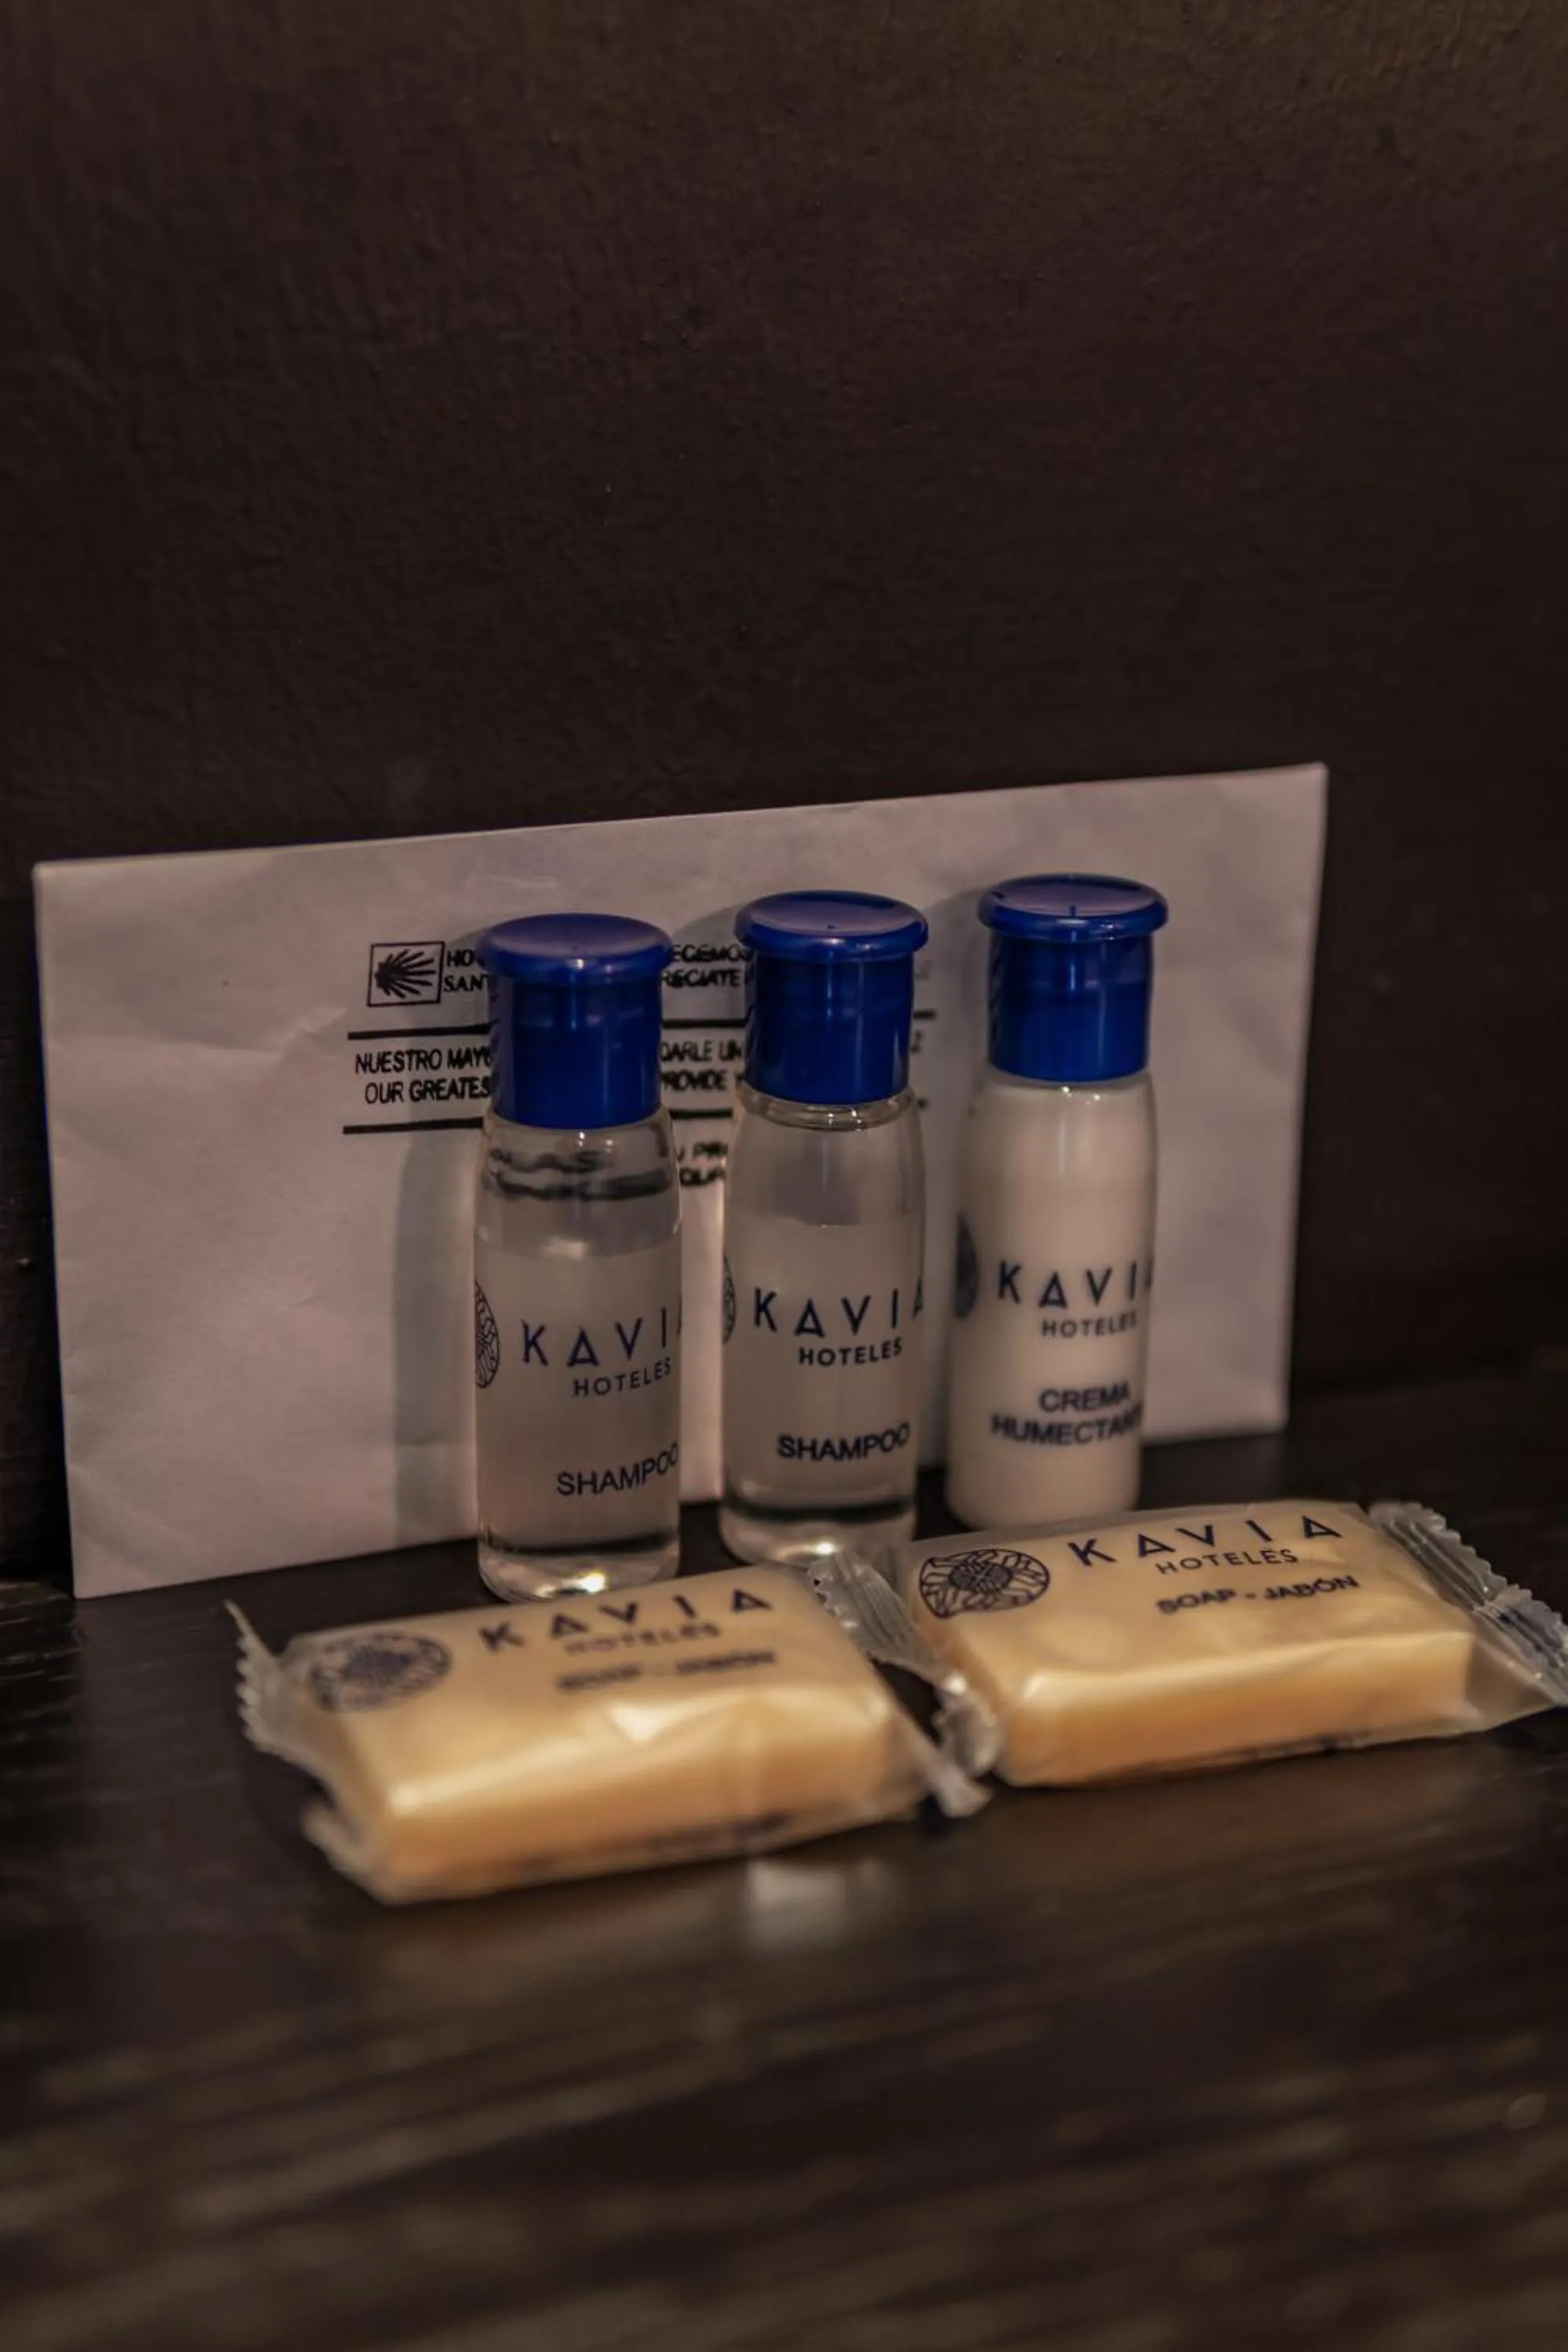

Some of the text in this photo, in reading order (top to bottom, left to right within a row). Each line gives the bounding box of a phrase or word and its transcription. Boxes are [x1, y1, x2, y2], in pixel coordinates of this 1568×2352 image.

[446, 948, 483, 967] HO
[355, 1047, 441, 1074] NUESTRO
[447, 1046, 494, 1070] MAYO
[365, 1080, 404, 1105] OUR
[408, 1075, 495, 1102] GREATES
[520, 1304, 681, 1367] KAVI
[798, 1336, 902, 1367] HOTELES
[572, 1357, 672, 1398] HOTELES
[777, 1421, 910, 1461] SHAMPOO
[557, 1439, 679, 1496] SHAMPOO
[1067, 1515, 1343, 1566] KAVIA
[1155, 1548, 1298, 1576] HOTELES
[1156, 1588, 1236, 1615] SOAP
[477, 1588, 774, 1653] KAVIA
